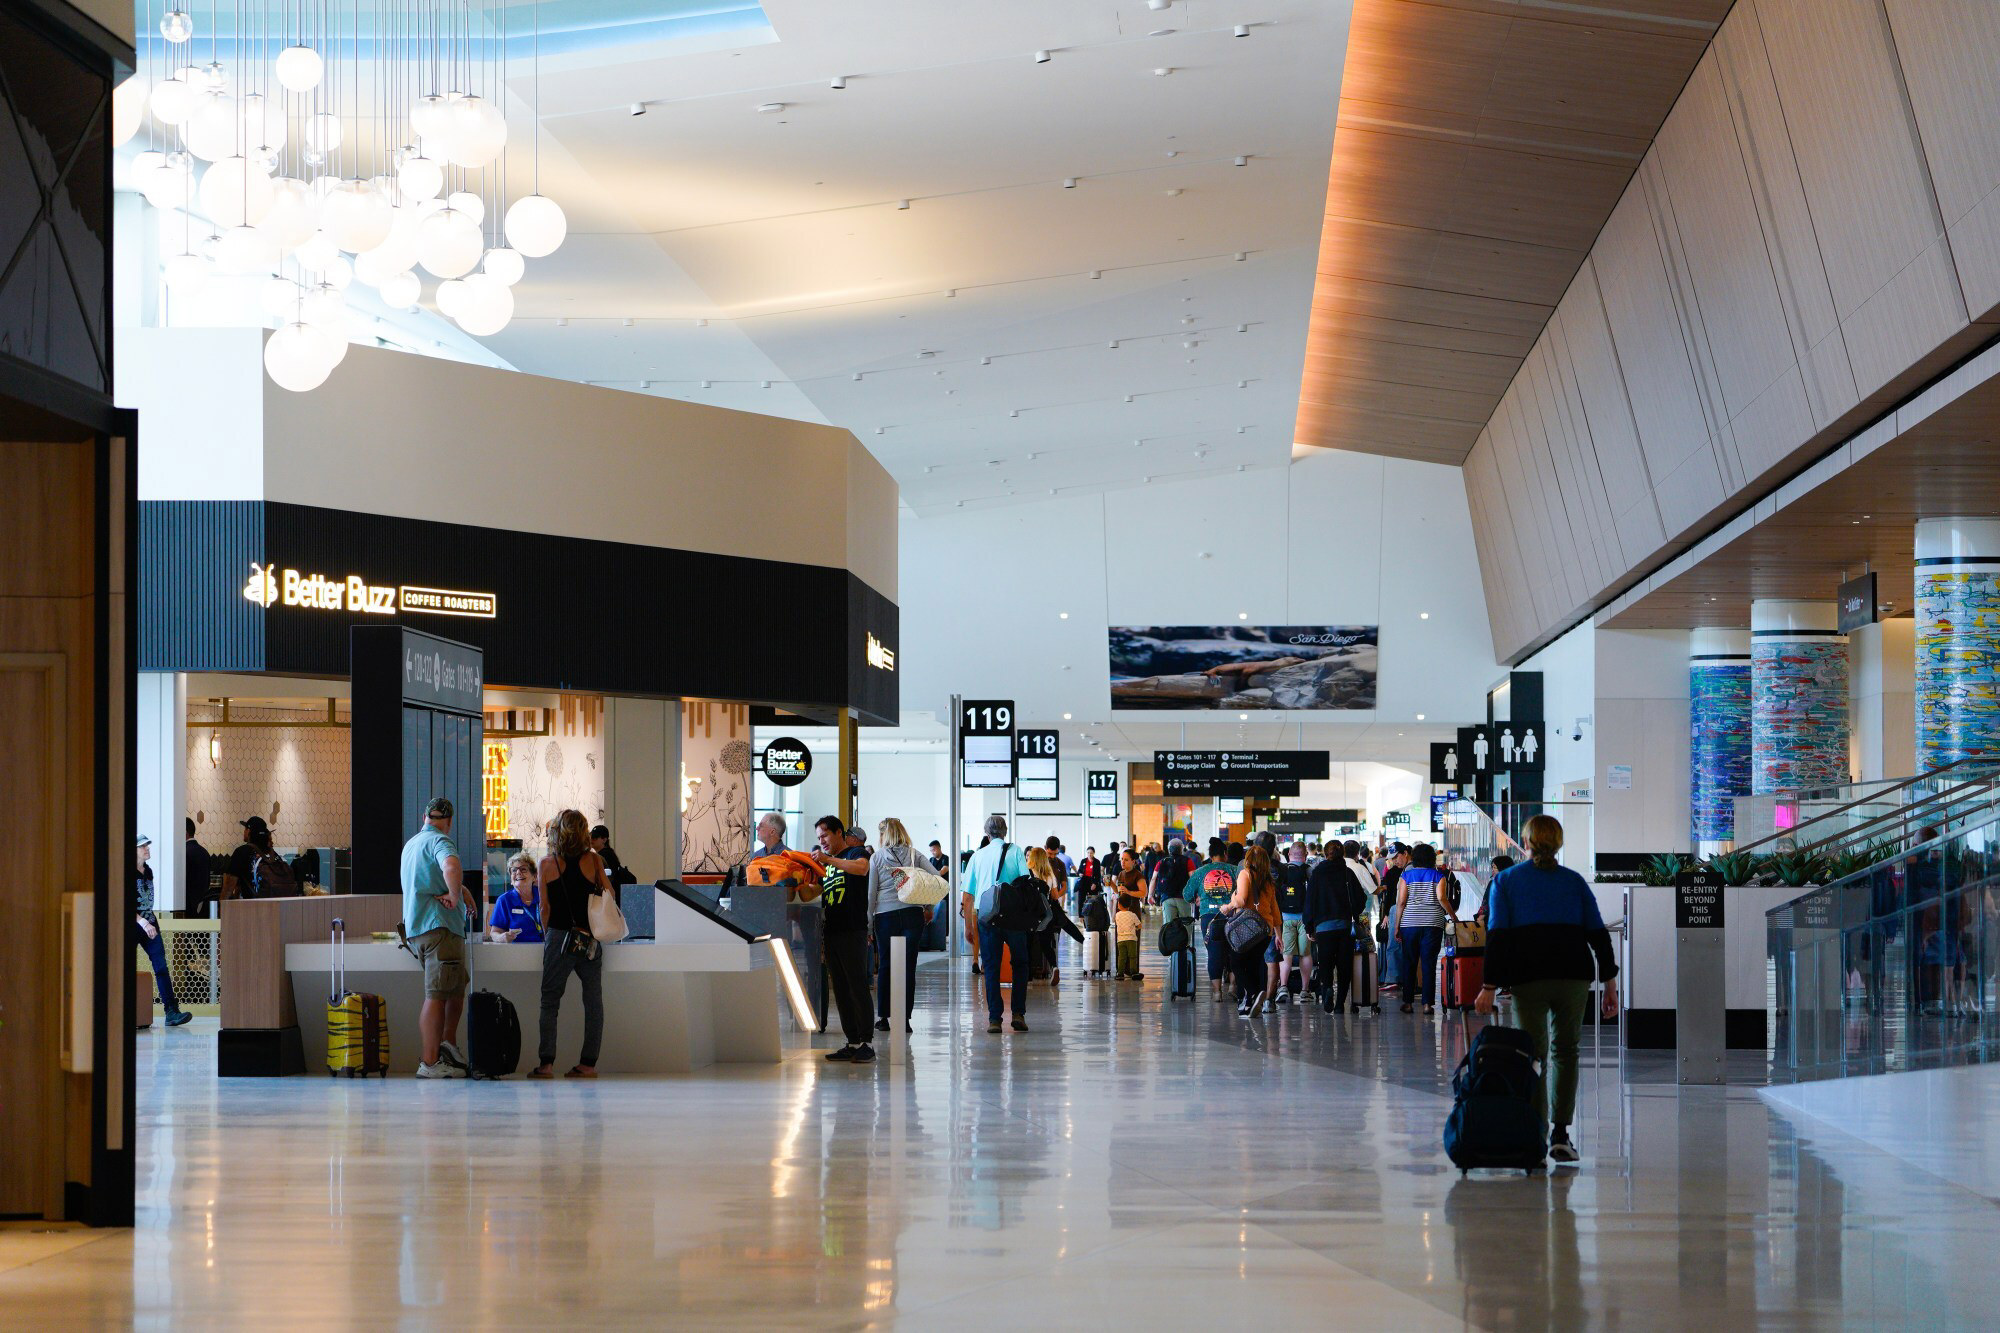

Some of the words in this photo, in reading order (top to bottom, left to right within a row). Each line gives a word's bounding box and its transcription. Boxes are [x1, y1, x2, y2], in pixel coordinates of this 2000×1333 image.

[282, 569, 346, 609] Better
[346, 575, 396, 614] Buzz
[405, 592, 441, 607] COFFEE
[444, 596, 491, 611] ROASTERS
[1289, 633, 1320, 644] San
[1320, 633, 1365, 645] Diego
[441, 659, 455, 689] Gates
[966, 707, 1010, 730] 119
[1020, 735, 1056, 754] 118
[767, 748, 803, 760] Better
[767, 759, 797, 770] Buzz
[1251, 762, 1289, 770] Transportation
[1090, 774, 1115, 788] 117
[1386, 817, 1394, 825] 11
[1396, 815, 1409, 823] 113
[1693, 876, 1706, 884] NO
[1681, 886, 1718, 894] RE-ENTRY
[1684, 896, 1716, 904] BEYOND
[1691, 906, 1709, 914] THIS
[1688, 916, 1712, 924] POINT
